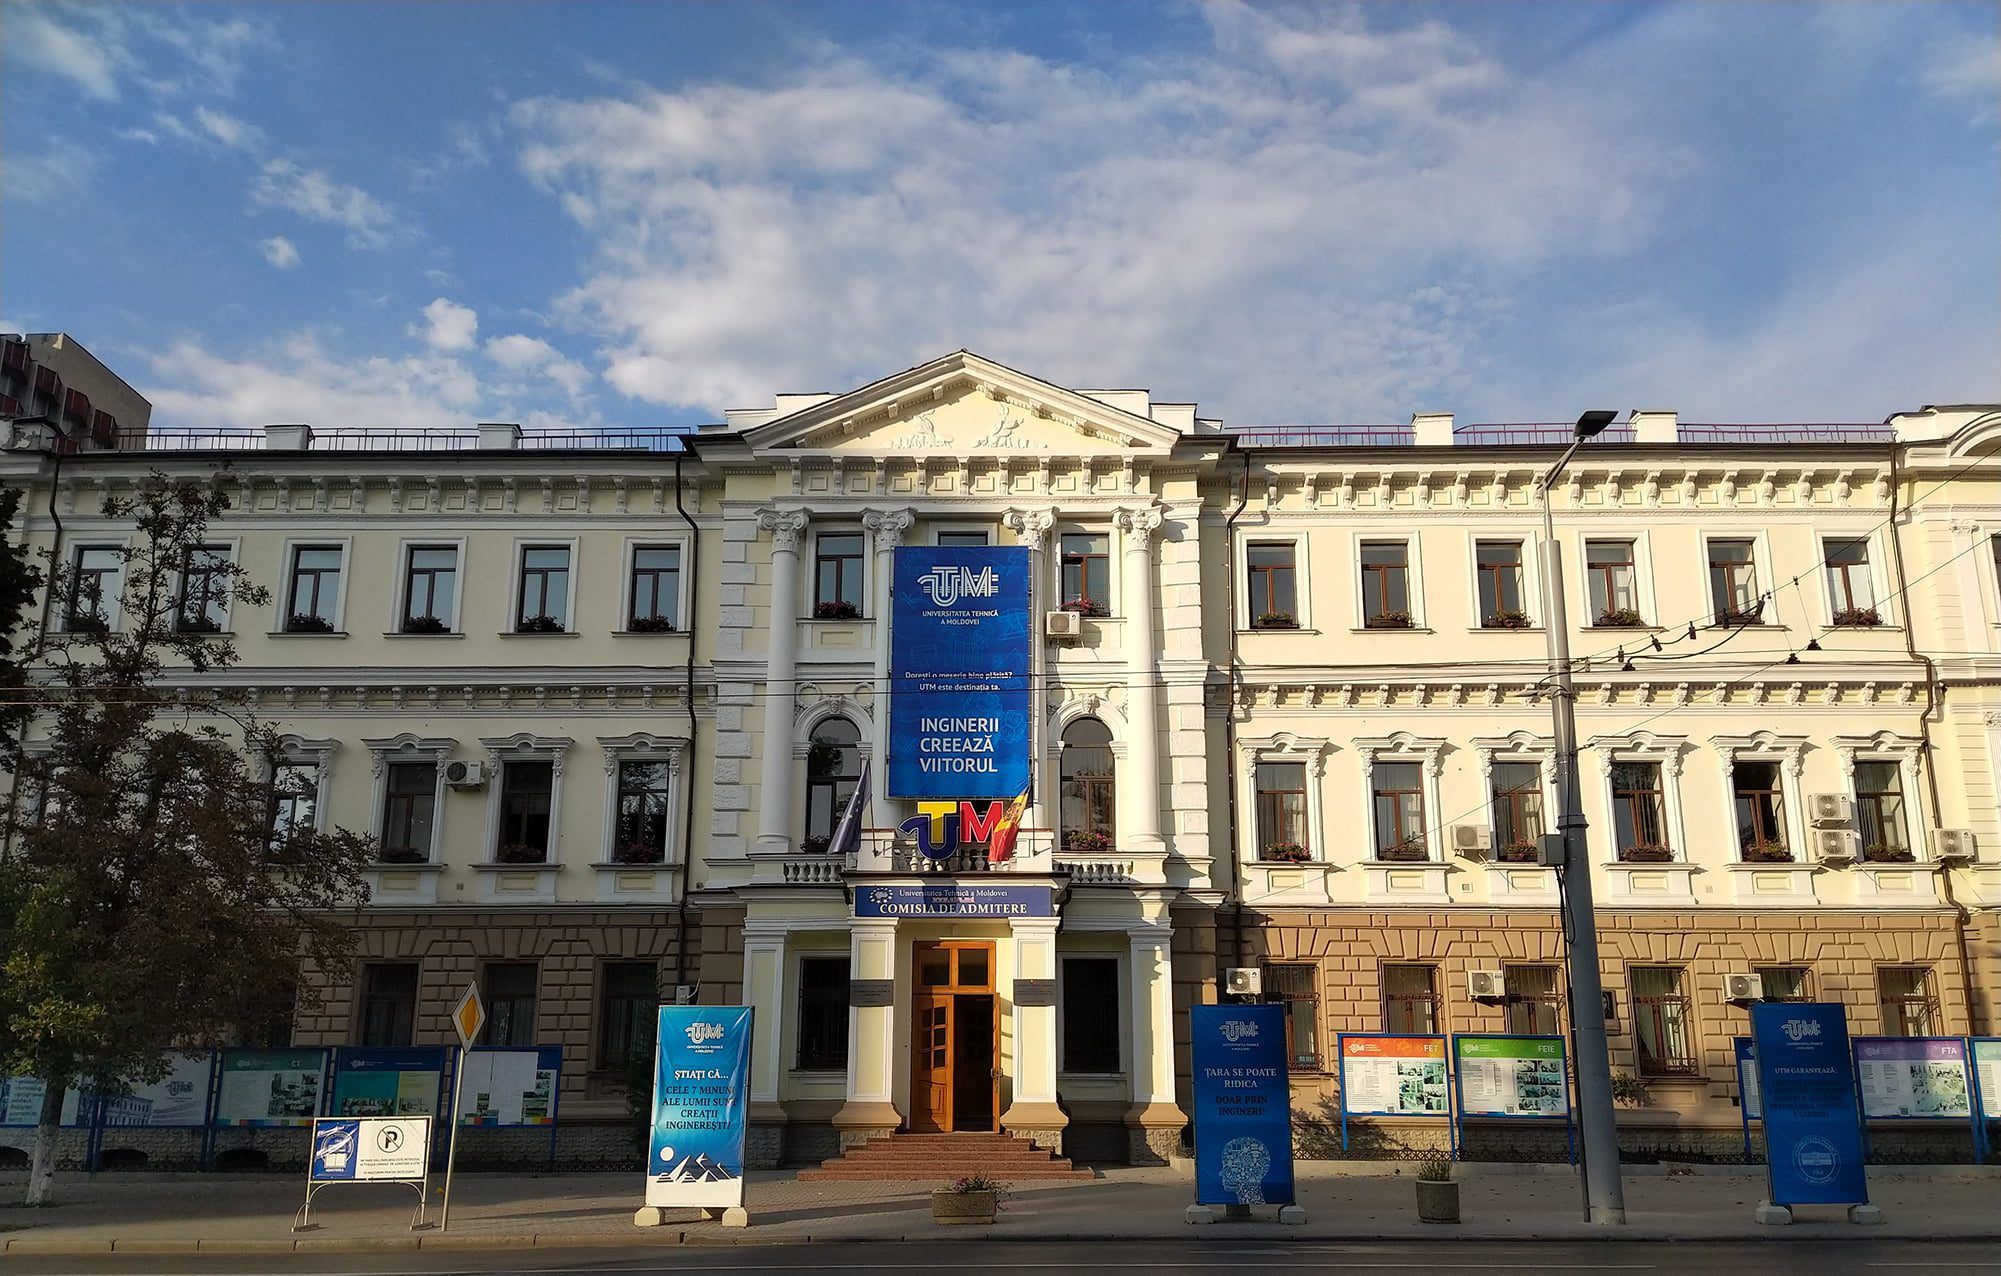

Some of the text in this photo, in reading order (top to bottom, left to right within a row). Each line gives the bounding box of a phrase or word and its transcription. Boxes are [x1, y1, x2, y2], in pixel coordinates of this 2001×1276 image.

[917, 566, 999, 607] UTM
[971, 609, 999, 617] TEHNICĂ
[919, 683, 936, 691] UTM
[954, 683, 990, 692] destinația
[920, 717, 999, 733] INGINERII
[920, 734, 994, 752] CREEAZĂ
[919, 757, 998, 773] VIITORUL
[898, 801, 1004, 861] UTM
[899, 889, 944, 897] Universitatea
[944, 889, 969, 897] Tehnică
[976, 889, 1008, 897] Moldovei
[879, 903, 1027, 914] COMISIA DE ADMITERE
[1424, 1044, 1439, 1053] FET
[1538, 1045, 1556, 1053] FEIE
[1941, 1047, 1957, 1055] FTA
[674, 1068, 729, 1080] ȘTIAȚI CĂ...
[1204, 1068, 1277, 1078] ȚARA SE POATE
[1224, 1080, 1258, 1088] RIDICA
[666, 1086, 689, 1095] CELE
[692, 1086, 697, 1095] 7
[662, 1098, 680, 1106] ALE
[682, 1098, 711, 1106] LUMII
[1216, 1095, 1267, 1104] DOAR PRIN
[680, 1109, 718, 1120] CREAȚII
[666, 1121, 731, 1132] INGINEREȘTI?
